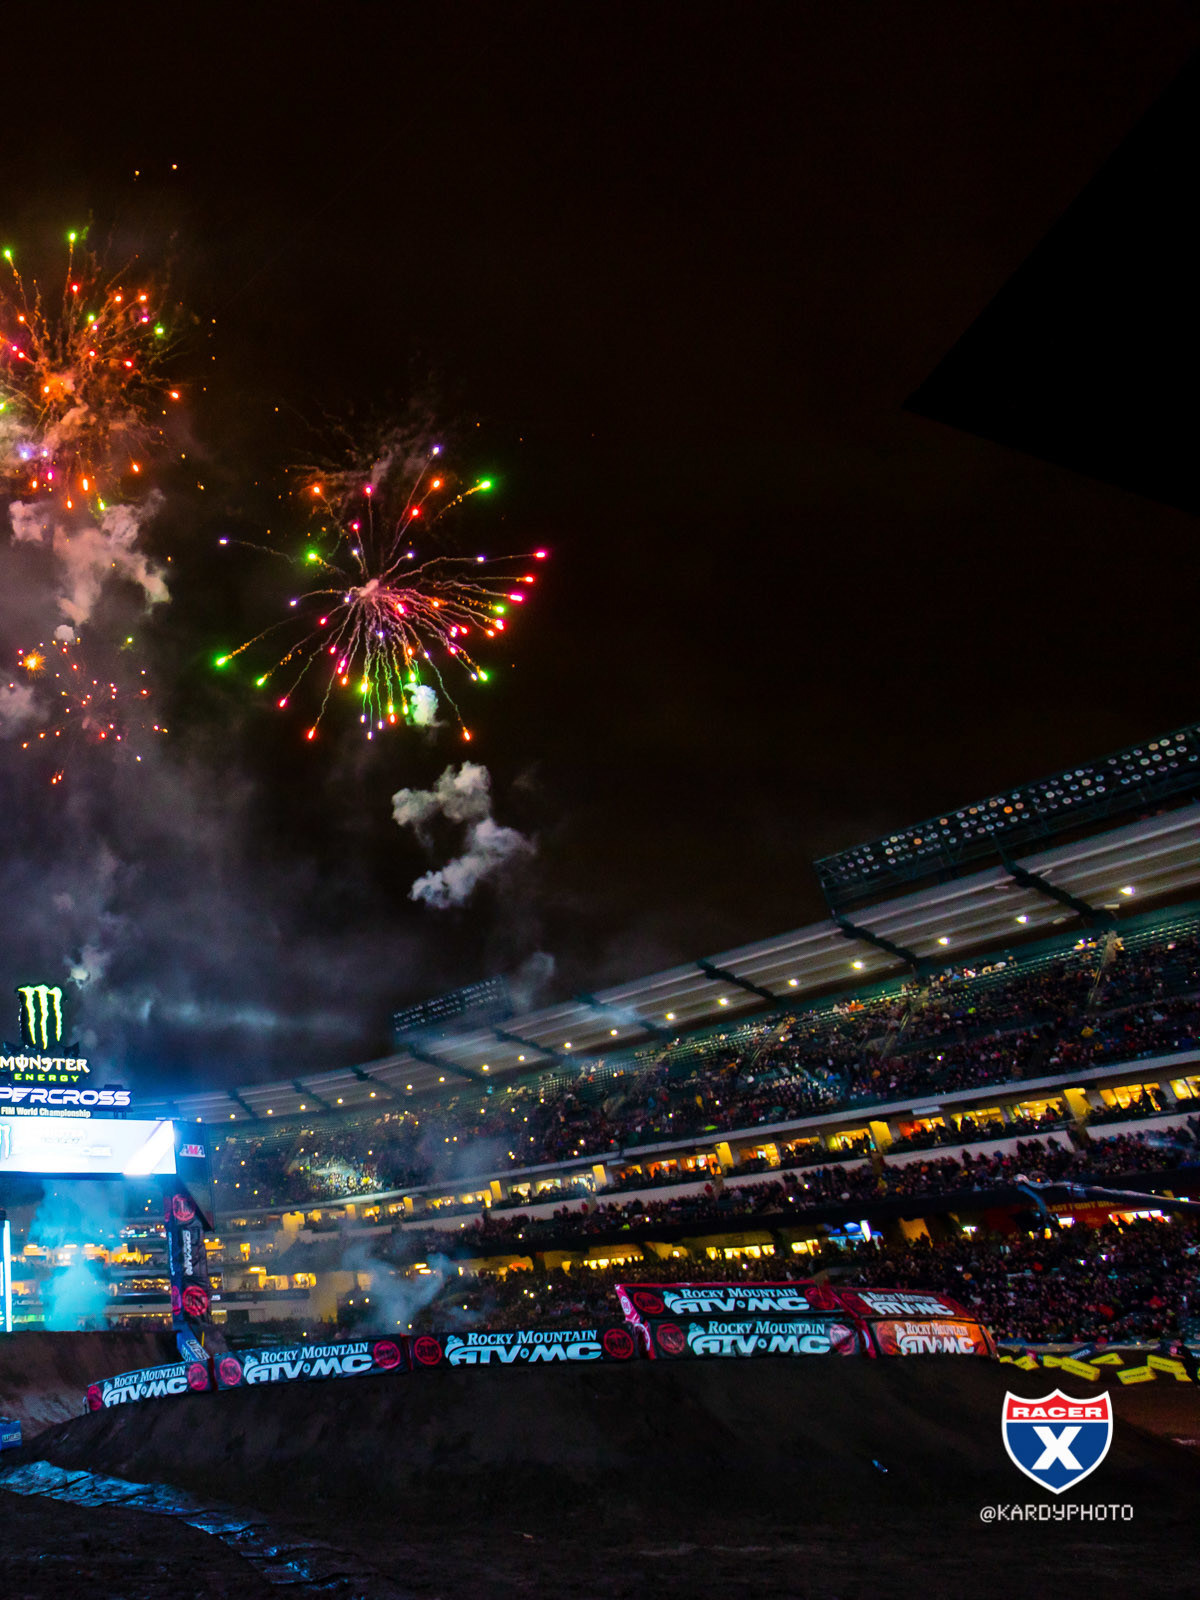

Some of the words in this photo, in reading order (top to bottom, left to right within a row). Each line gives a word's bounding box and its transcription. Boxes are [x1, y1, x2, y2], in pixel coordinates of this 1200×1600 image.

[0, 1054, 90, 1073] MONSTER
[14, 1073, 79, 1082] ENERGY
[1, 1106, 15, 1115] FIM
[16, 1107, 38, 1116] World
[39, 1108, 91, 1118] Championship
[179, 1144, 205, 1158] AMA
[680, 1288, 724, 1299] ROCKY
[728, 1287, 798, 1298] MOUNTAIN
[708, 1321, 751, 1335] ROCKY
[756, 1320, 825, 1335] MOUNTAIN
[905, 1322, 930, 1336] ROCKY
[467, 1332, 514, 1346] ROCKY
[517, 1330, 597, 1344] MOUNTAIN
[261, 1350, 297, 1364] ROCKY
[300, 1342, 369, 1360] MOUNTAIN
[114, 1373, 140, 1388] ROCKY
[140, 1366, 186, 1383] MOUNTAIN
